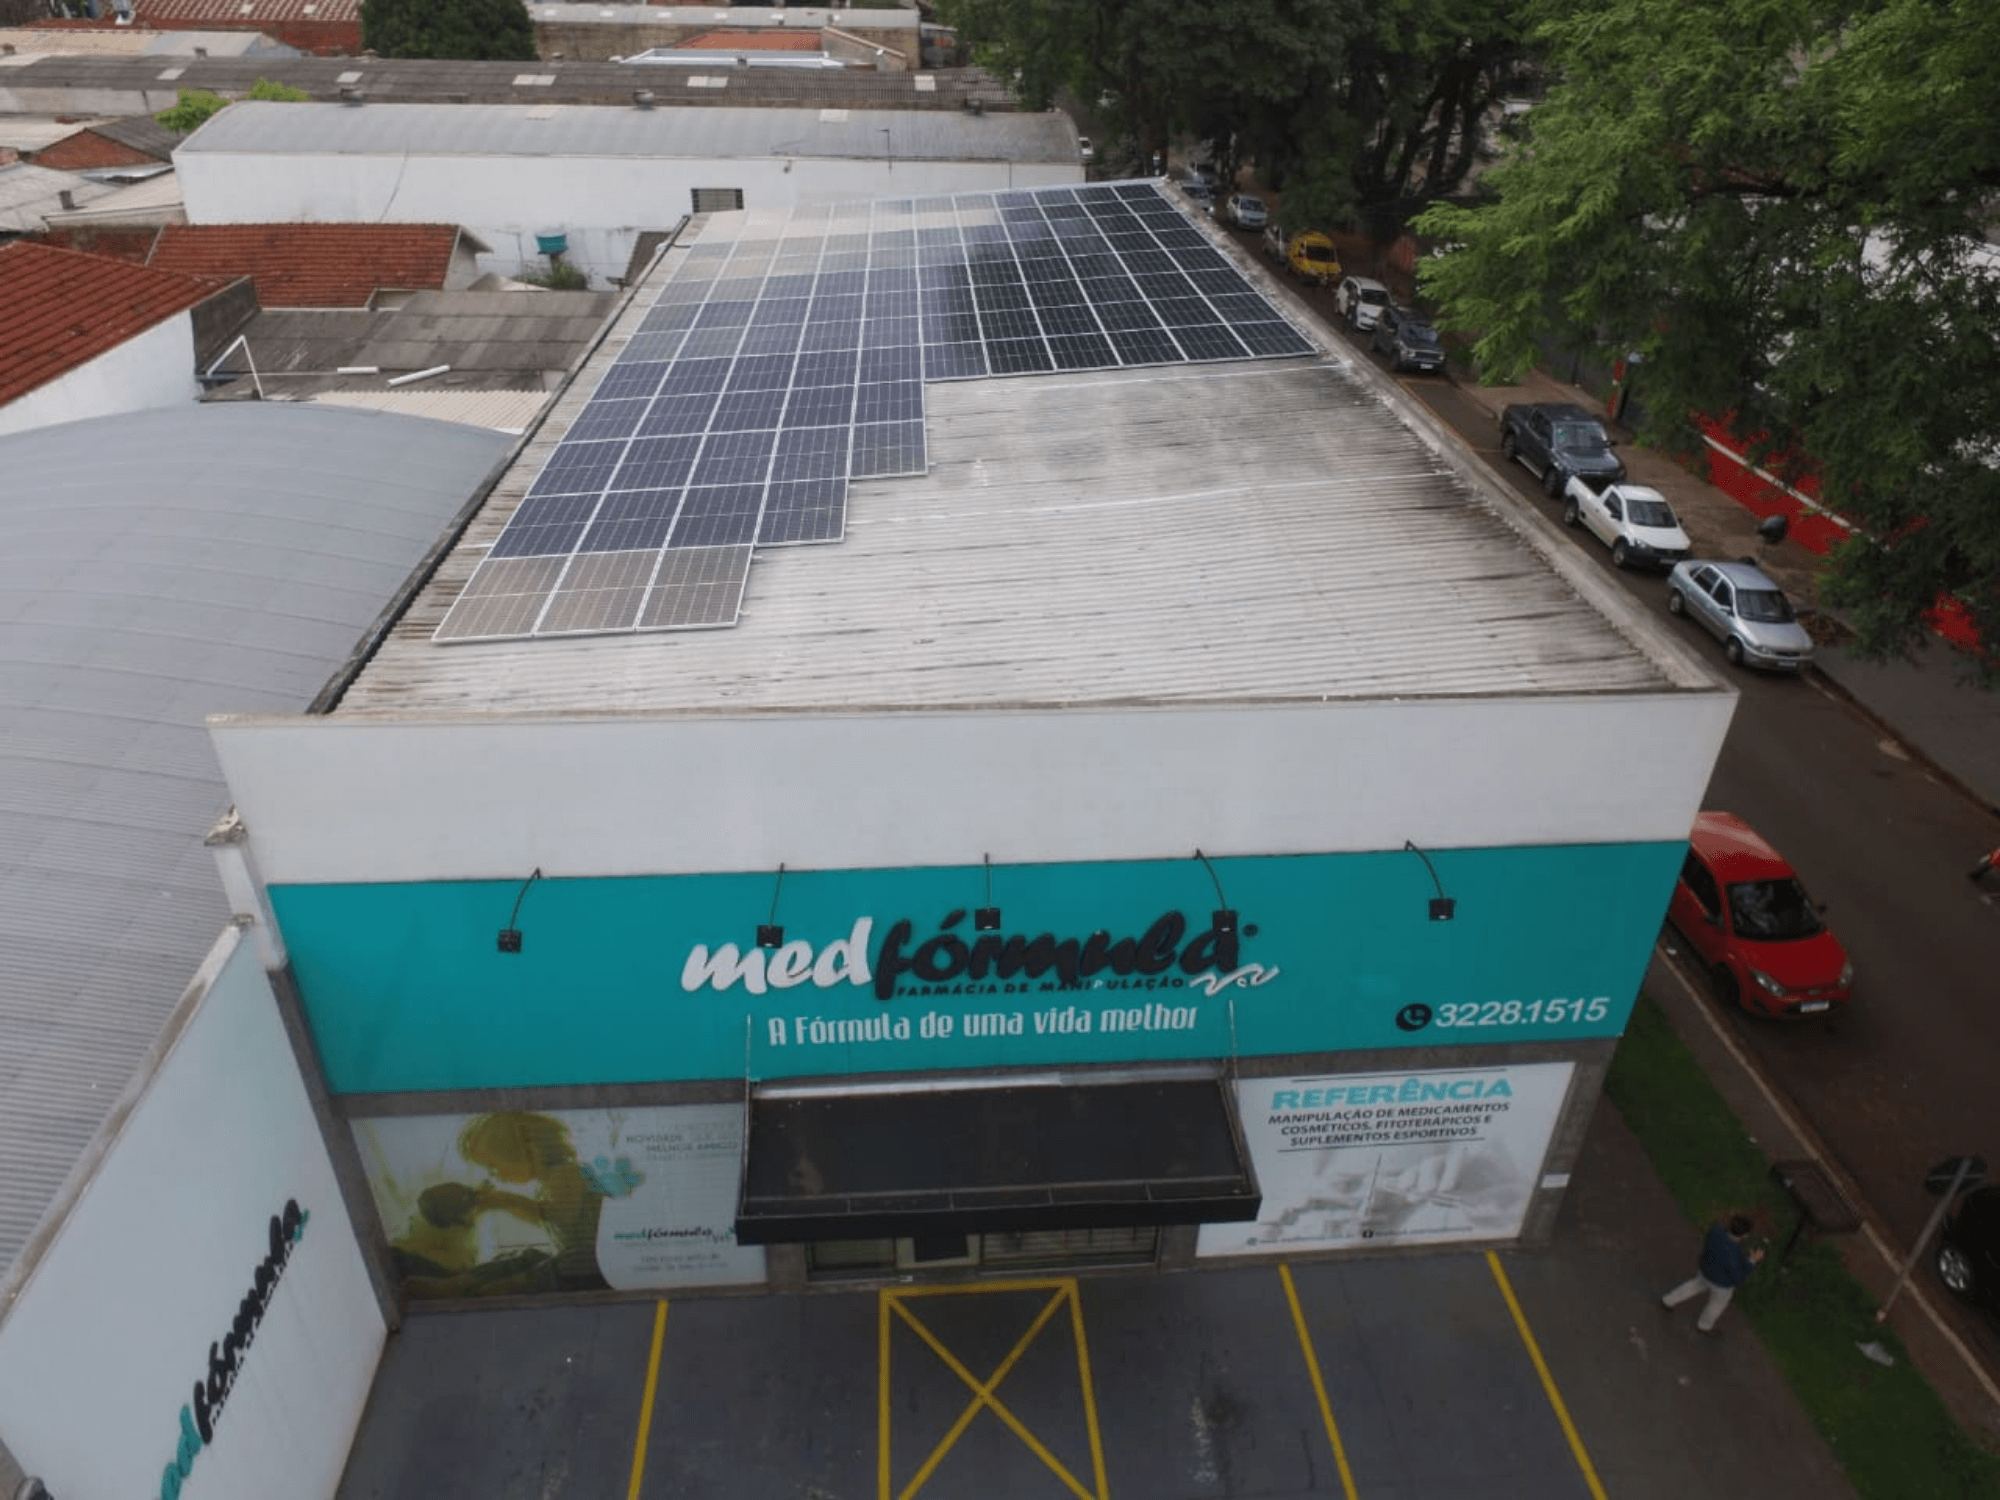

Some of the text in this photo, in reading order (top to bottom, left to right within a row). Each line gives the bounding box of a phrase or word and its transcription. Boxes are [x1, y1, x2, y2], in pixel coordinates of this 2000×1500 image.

[1004, 982, 1029, 994] DE
[1039, 975, 1184, 992] MANIPULAÇÃO
[767, 1002, 1198, 1046] A Fórmula de uma vida melhor
[1435, 996, 1610, 1028] 3228.1515
[1271, 1076, 1513, 1110] REFERÊNCIA
[1268, 1101, 1509, 1125] MANIPULAÇÃO DE MEDICAMENTOS
[1376, 1114, 1480, 1130] FITOTERÁPICOS
[1483, 1114, 1493, 1124] E
[1290, 1126, 1477, 1147] SUPLEMENTOS ESPORTIVOS
